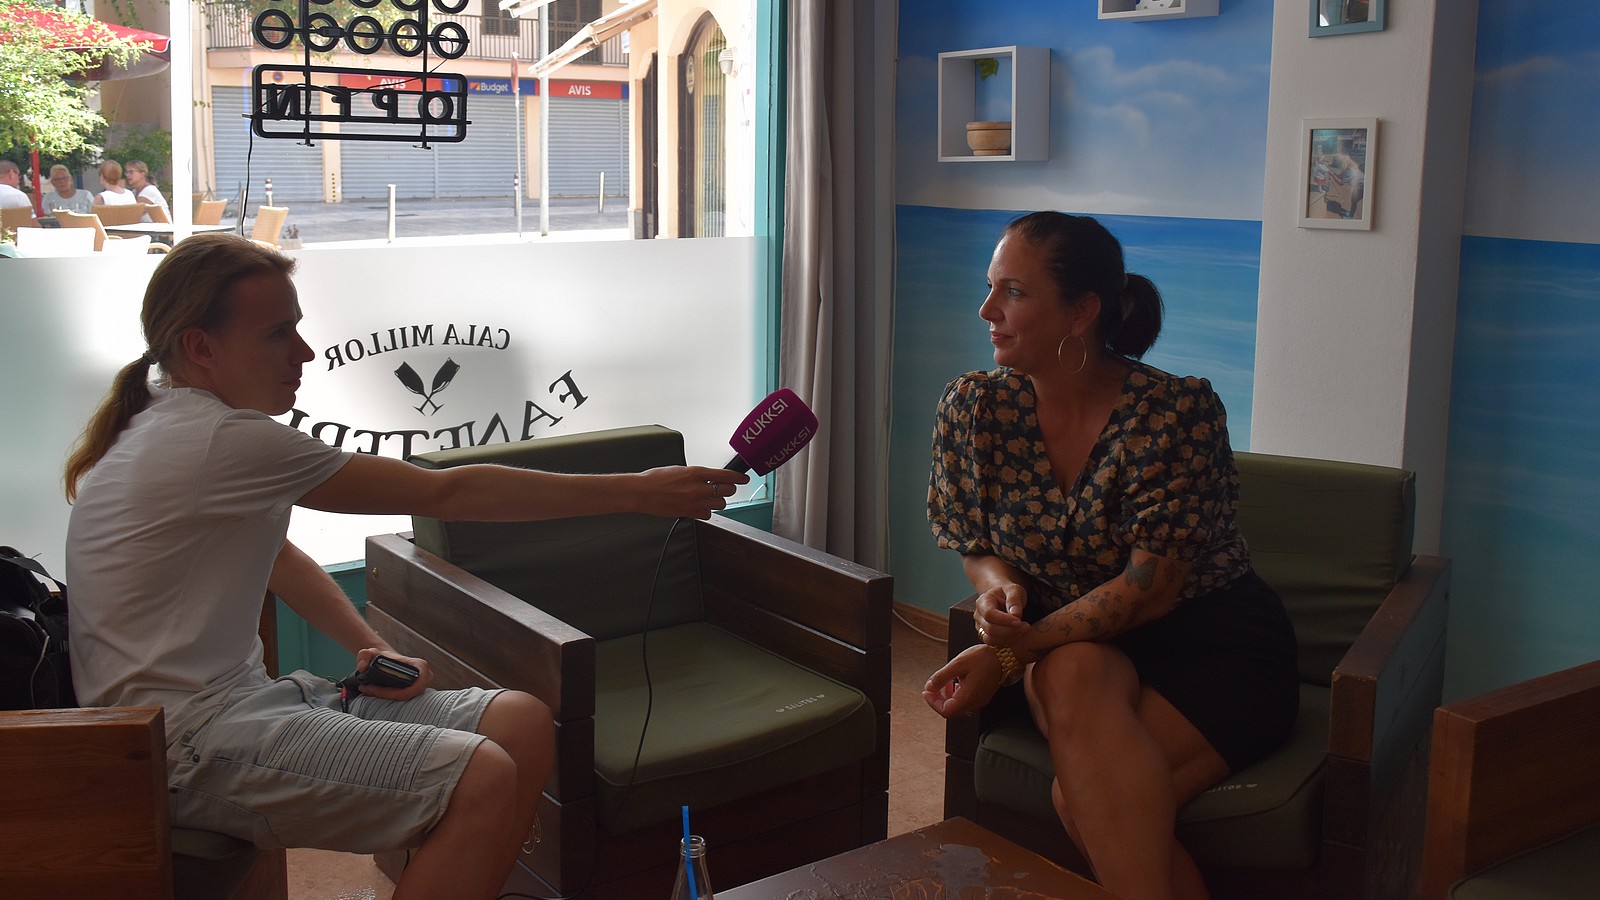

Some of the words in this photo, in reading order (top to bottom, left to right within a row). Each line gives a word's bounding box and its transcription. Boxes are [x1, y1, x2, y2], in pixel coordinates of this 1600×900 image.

[380, 78, 406, 90] AVIS
[480, 82, 509, 93] Budget
[568, 85, 591, 96] AVIS
[742, 398, 789, 445] KUKKSI
[765, 426, 811, 468] KUKKSI
